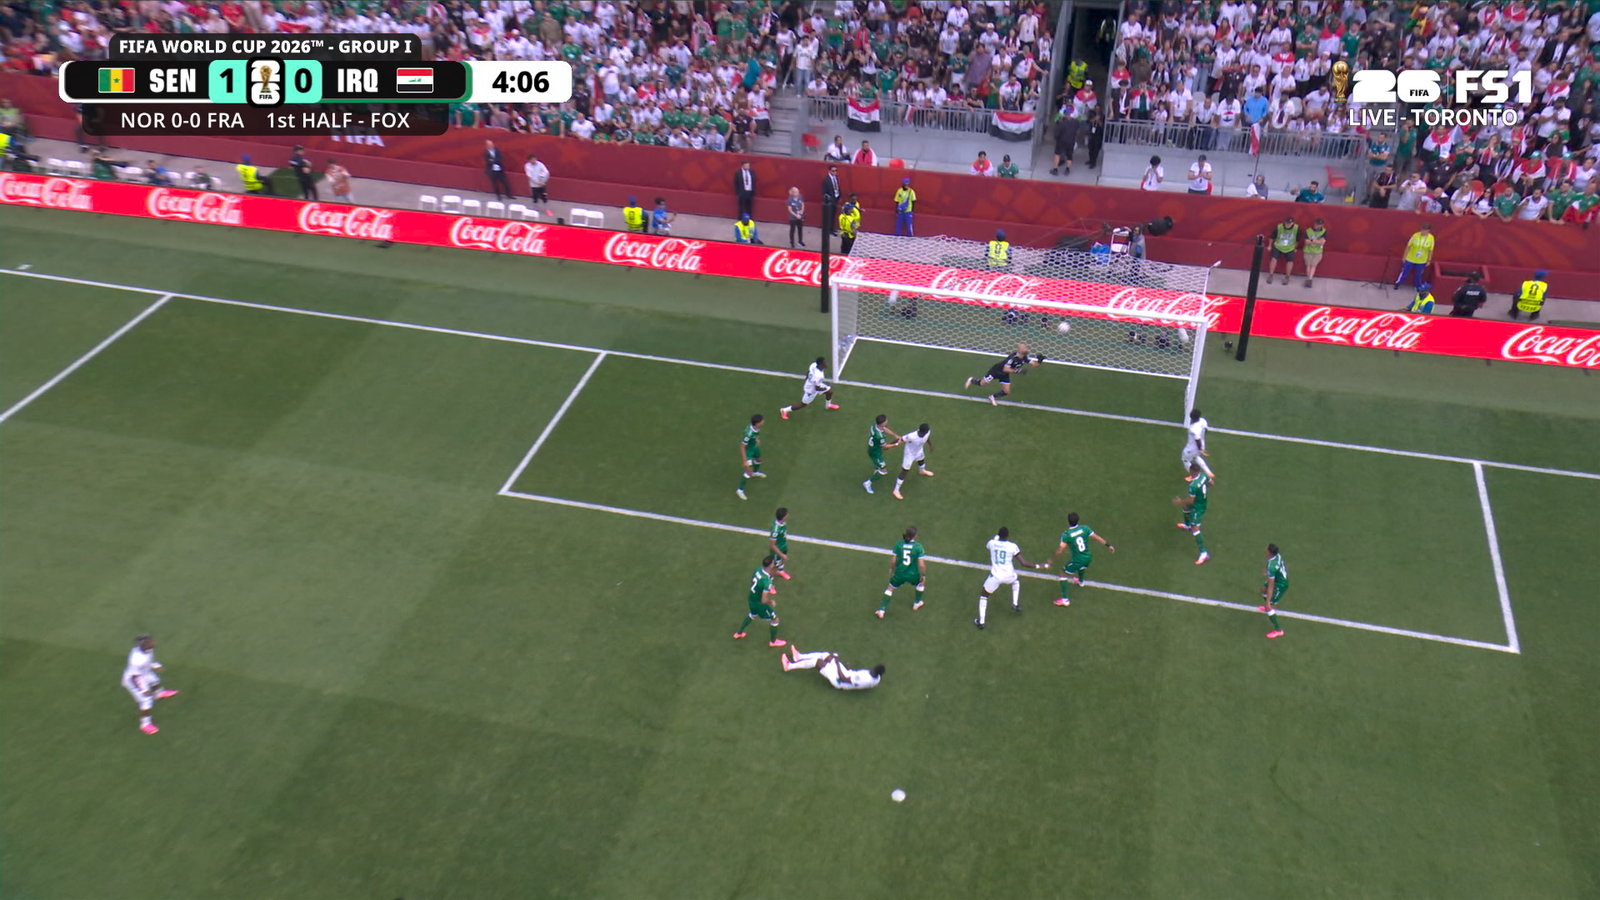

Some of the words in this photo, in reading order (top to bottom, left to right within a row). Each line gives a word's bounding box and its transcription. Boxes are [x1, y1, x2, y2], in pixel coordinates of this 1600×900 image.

[450, 216, 548, 254] Coca-Cola
[604, 232, 706, 272] Coca-Cola
[1294, 305, 1434, 350] Coca-Cola
[1075, 536, 1086, 552] 8
[902, 549, 912, 566] 5
[993, 549, 1007, 565] 19
[750, 576, 758, 594] 2
